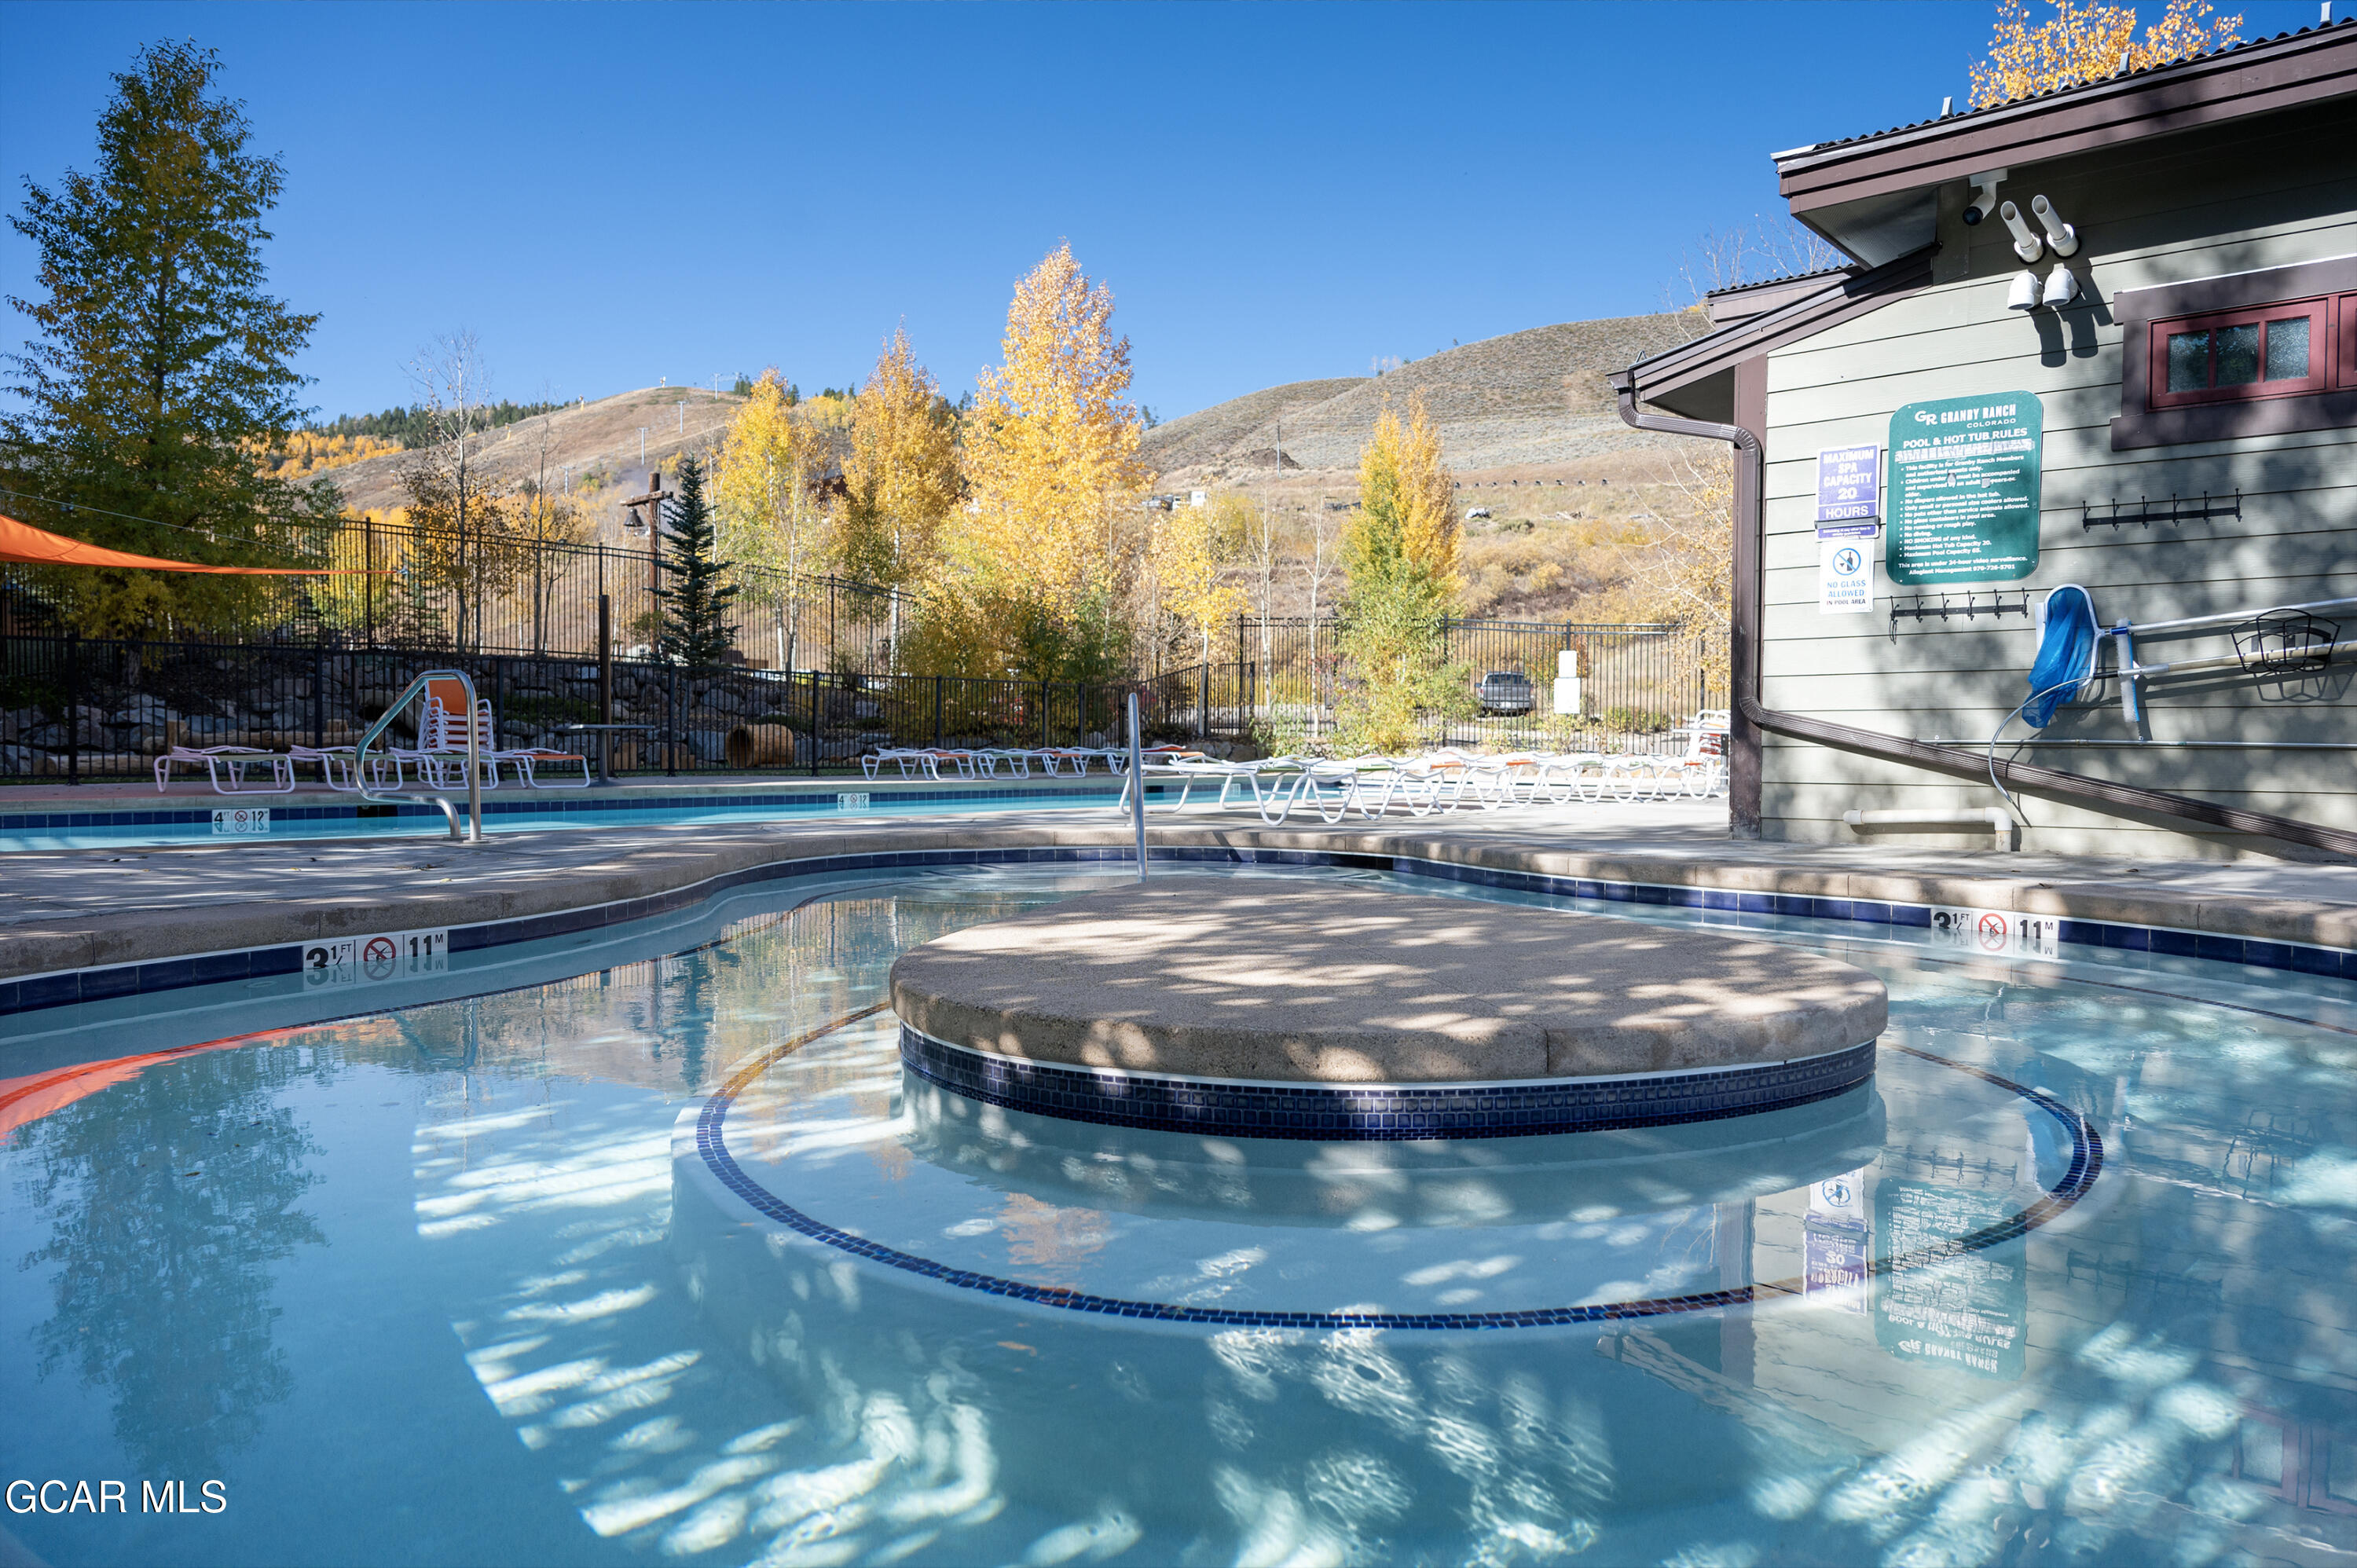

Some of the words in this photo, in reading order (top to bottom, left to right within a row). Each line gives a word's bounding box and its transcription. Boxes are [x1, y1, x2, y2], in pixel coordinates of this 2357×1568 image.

[1915, 410, 1937, 426] GR
[1941, 408, 1979, 424] GRANBY
[1982, 404, 2016, 419] RANCH
[1967, 418, 2017, 429] COLORADO
[1903, 438, 1930, 449] POOL
[1933, 437, 1941, 445] &
[1943, 434, 1966, 445] HOT
[1968, 431, 1989, 441] TUB
[1992, 427, 2028, 440] RULES
[1823, 449, 1875, 464] MAXIMUM
[1838, 462, 1857, 474] SPA
[1917, 468, 1948, 477] authorized
[1981, 468, 2021, 477] accompanied
[1824, 471, 1872, 488] CAPACITY
[1837, 486, 1858, 500] 20
[1941, 500, 1967, 509] personal
[1825, 505, 1869, 519] HOURS
[1934, 566, 1972, 574] Management
[1841, 579, 1867, 588] GLASS
[1827, 588, 1865, 598] ALLOWED
[214, 811, 224, 822] 4
[2045, 921, 2054, 931] M
[435, 933, 444, 943] M
[341, 943, 352, 953] FT
